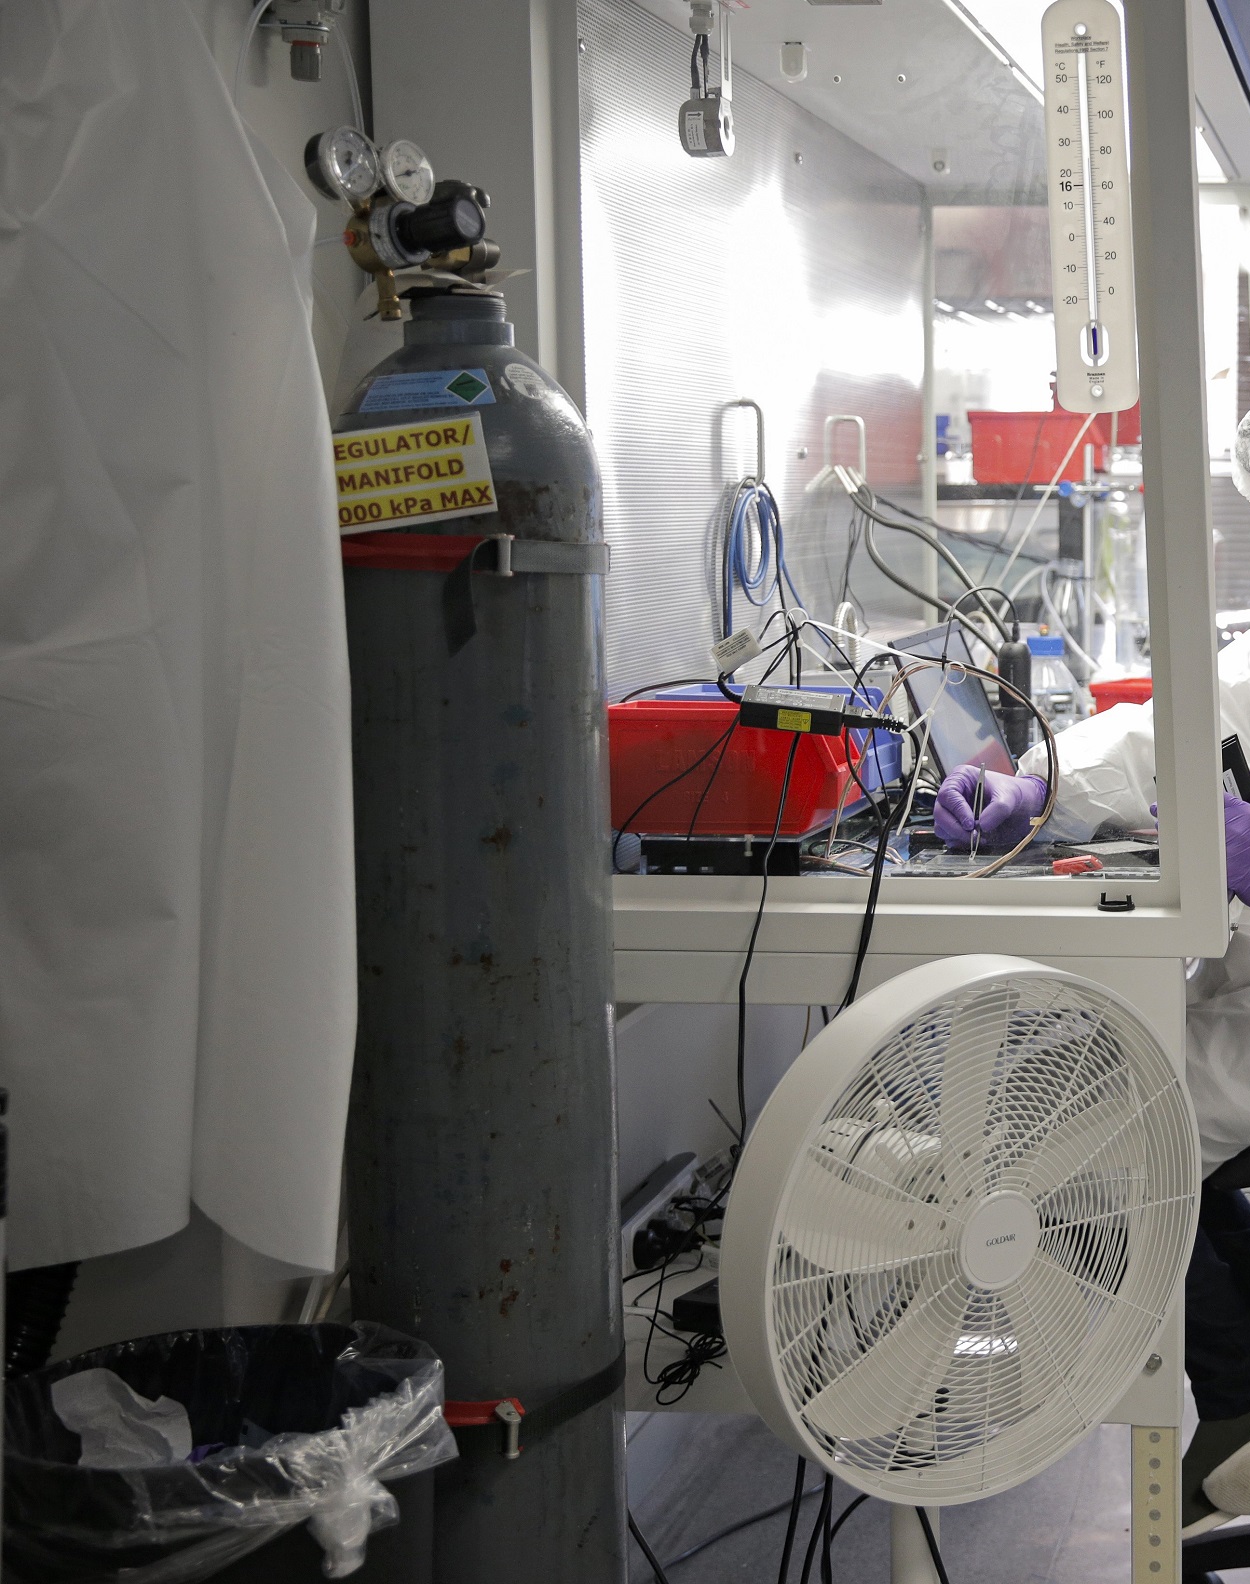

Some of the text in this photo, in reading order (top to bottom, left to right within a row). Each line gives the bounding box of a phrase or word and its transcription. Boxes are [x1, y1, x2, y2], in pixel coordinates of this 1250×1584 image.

[1055, 62, 1066, 71] °C
[1096, 60, 1105, 68] °F
[1055, 74, 1068, 83] 50
[1096, 75, 1112, 84] 120
[1057, 105, 1069, 114] 40
[1097, 110, 1114, 119] 100
[1058, 138, 1070, 147] 30
[1099, 146, 1112, 155] 80
[1060, 169, 1072, 178] 20
[1060, 181, 1073, 192] 16
[1101, 181, 1114, 190] 60
[1063, 201, 1074, 210] 10
[1103, 216, 1115, 225] 40
[1069, 233, 1075, 241] 0
[1104, 251, 1117, 260] 20
[1063, 264, 1077, 273] -10
[1108, 286, 1115, 295] 0
[1062, 296, 1078, 304] -20
[333, 424, 470, 461] EGULATOR/
[338, 458, 464, 492] MANIFOLD
[338, 485, 493, 524] 000 kPa MAX
[986, 1233, 1016, 1246] GOLDAIR
